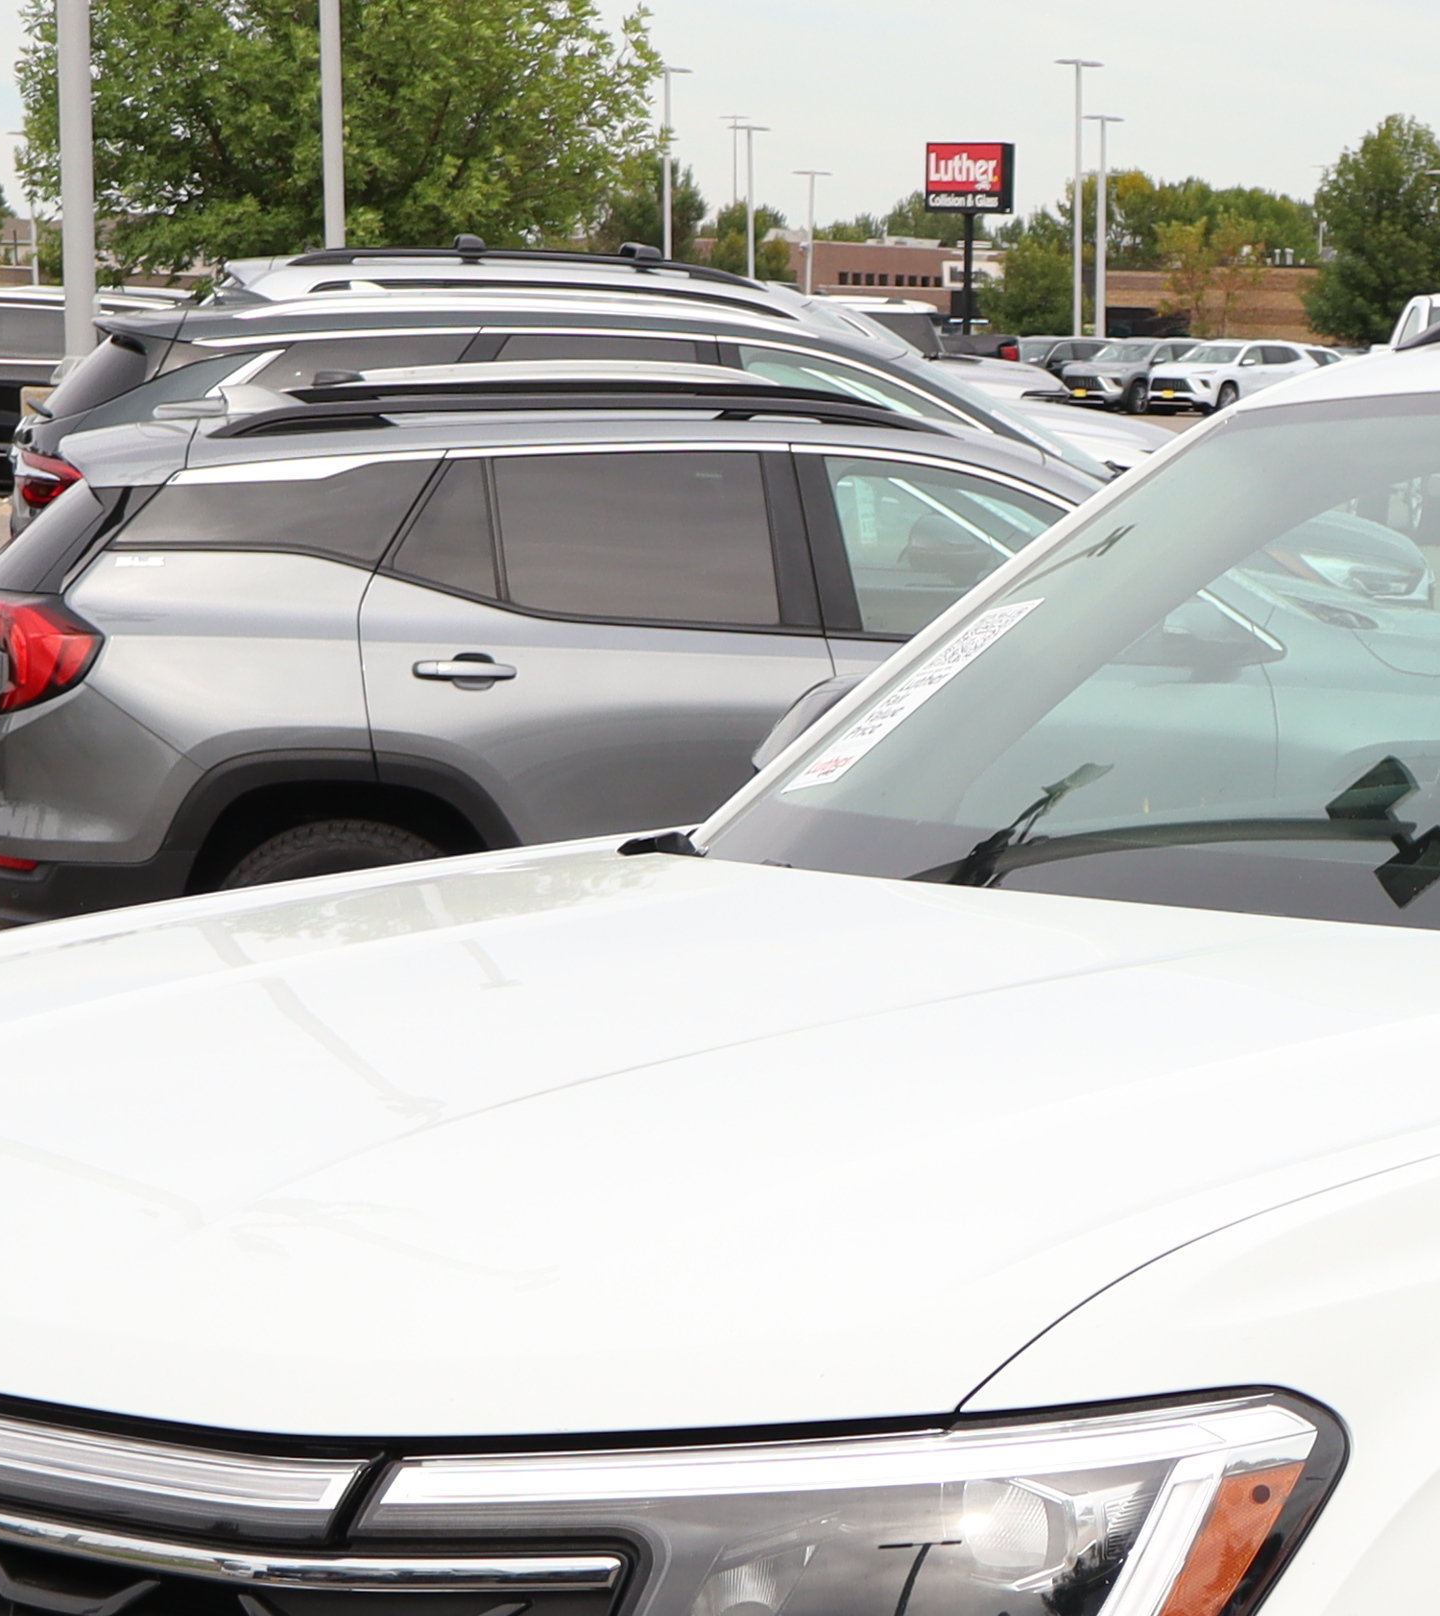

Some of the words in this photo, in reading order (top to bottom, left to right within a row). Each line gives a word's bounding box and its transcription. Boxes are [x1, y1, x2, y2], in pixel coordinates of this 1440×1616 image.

[929, 152, 997, 182] Luther
[929, 193, 965, 207] Collision
[966, 193, 974, 207] &
[975, 193, 999, 207] Glass
